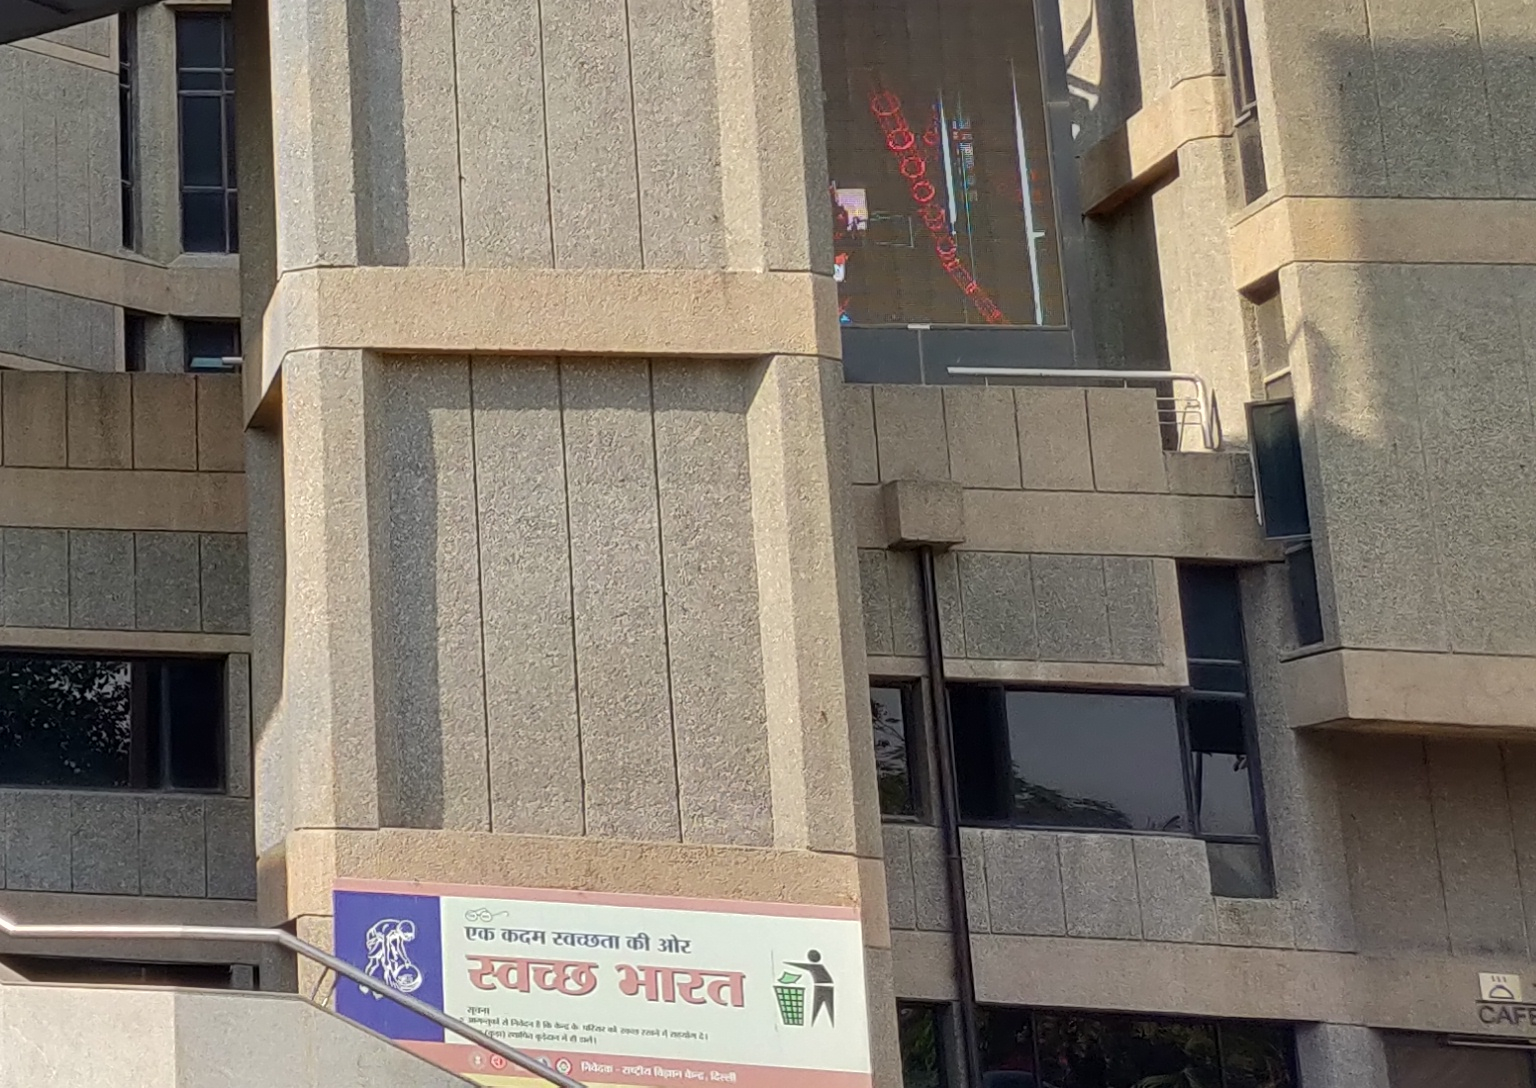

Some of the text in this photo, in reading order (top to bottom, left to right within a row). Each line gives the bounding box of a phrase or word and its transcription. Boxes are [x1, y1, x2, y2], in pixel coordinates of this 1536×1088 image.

[464, 926, 691, 953] एक कदम स्वच्छता की ओर
[465, 954, 746, 1008] स्वच्छ भारत
[581, 1061, 613, 1073] निवेदक
